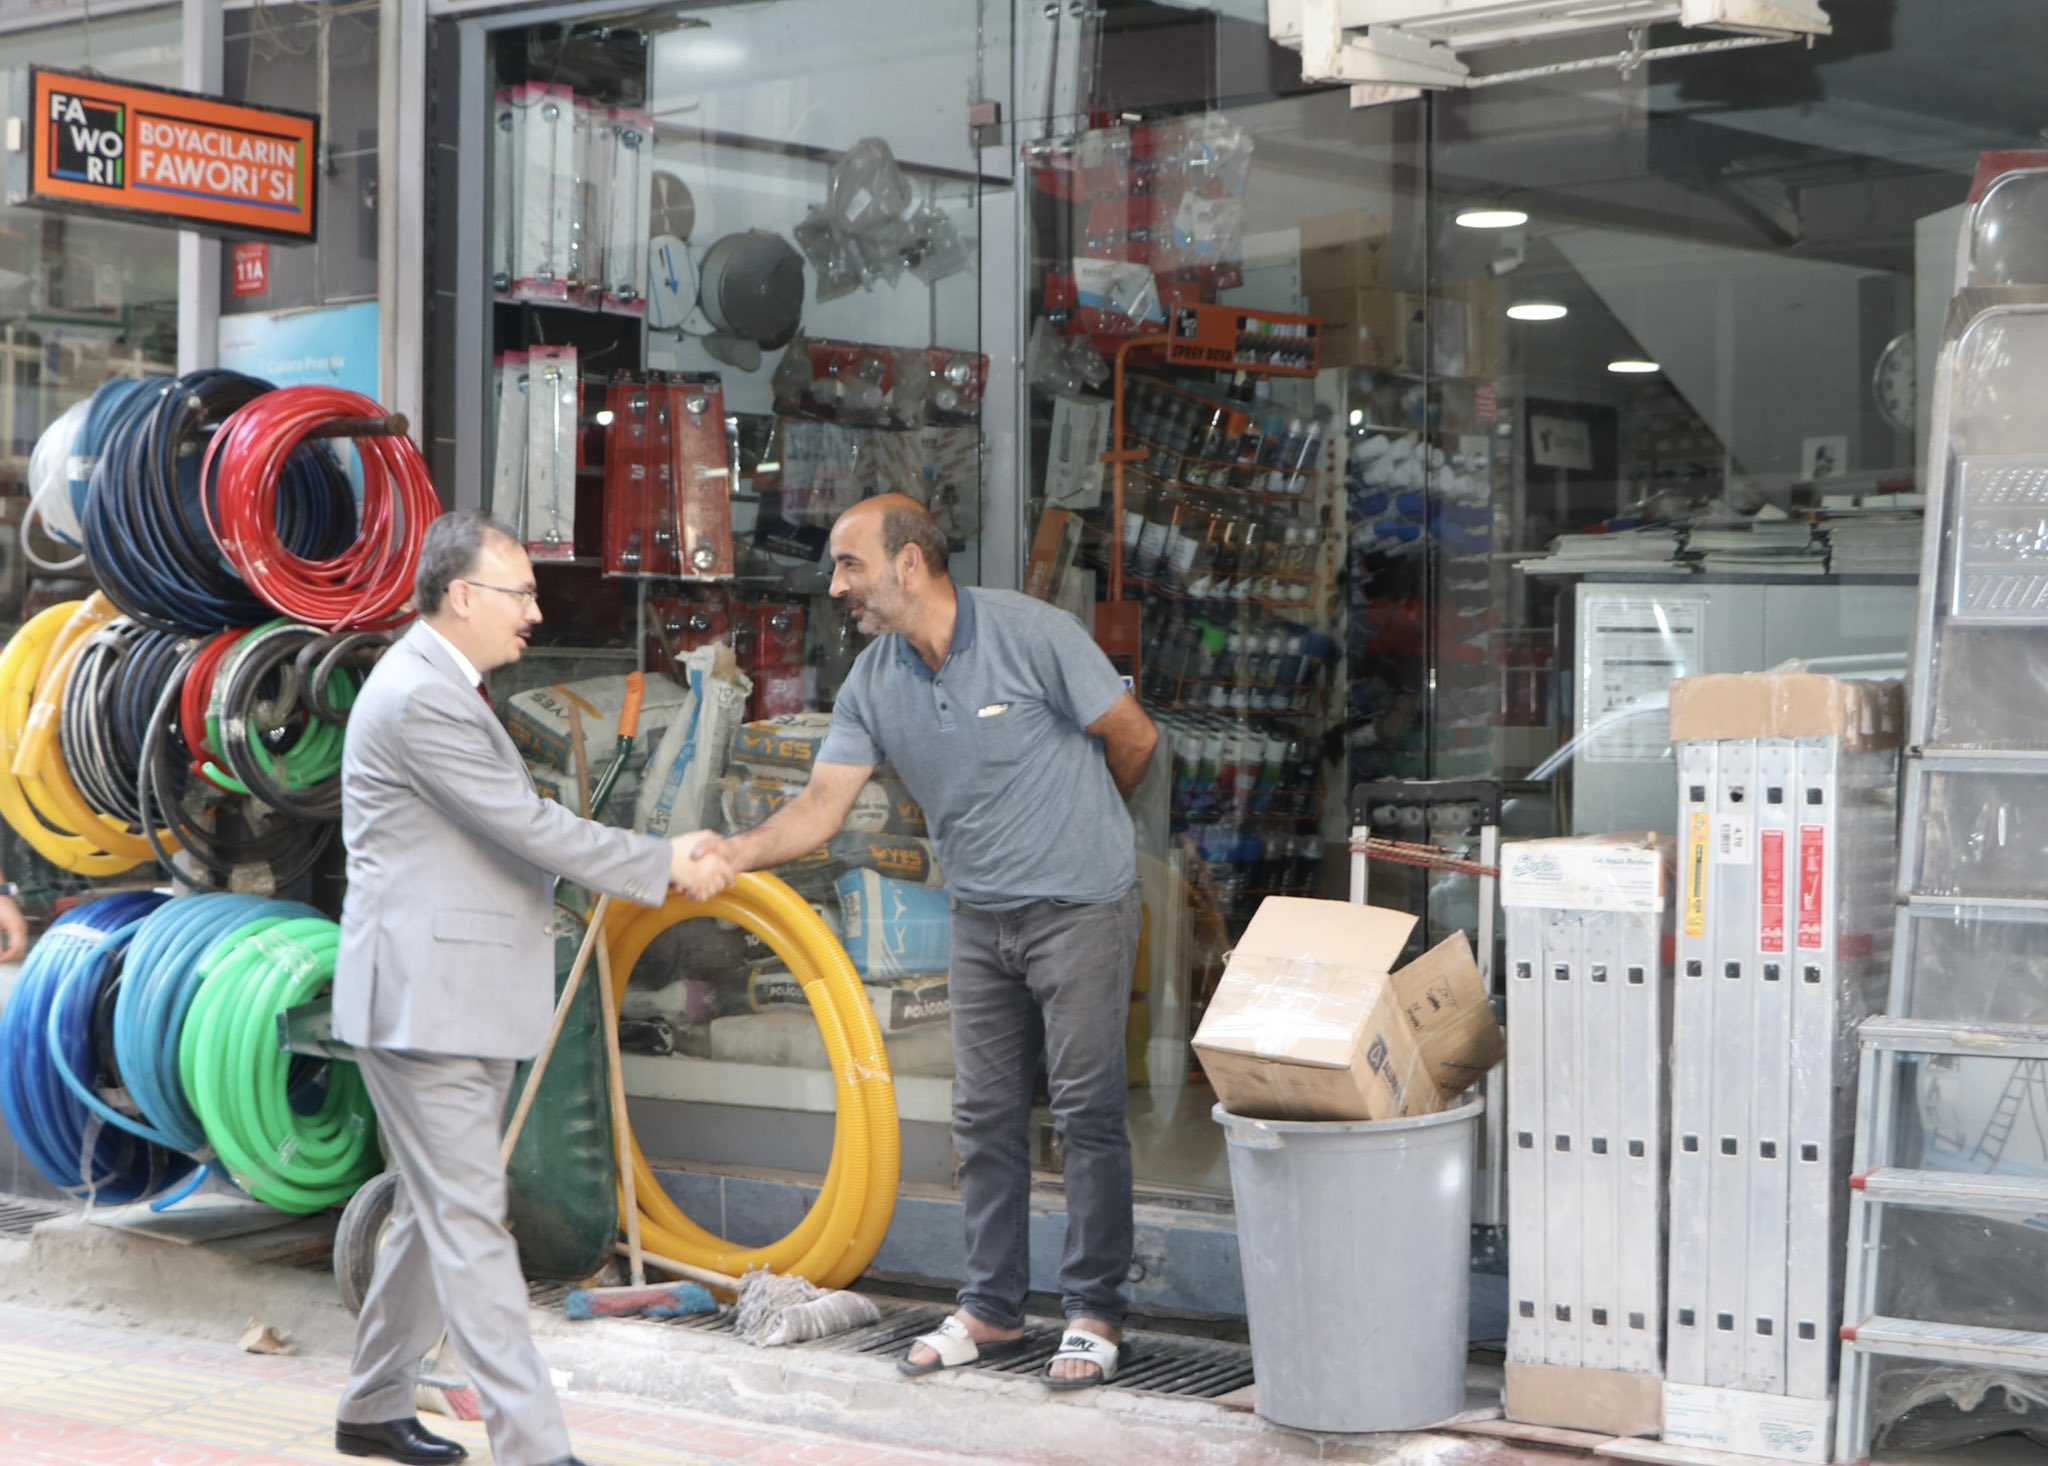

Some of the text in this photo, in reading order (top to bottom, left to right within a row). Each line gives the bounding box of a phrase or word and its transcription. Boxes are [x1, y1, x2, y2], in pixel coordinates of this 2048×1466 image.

[51, 93, 87, 126] FA
[70, 125, 123, 158] WO
[138, 120, 296, 169] BOYACILARIN
[237, 260, 263, 281] 11A
[764, 738, 812, 760] YES
[889, 848, 922, 868] YES
[1065, 1335, 1100, 1351] NIKE
